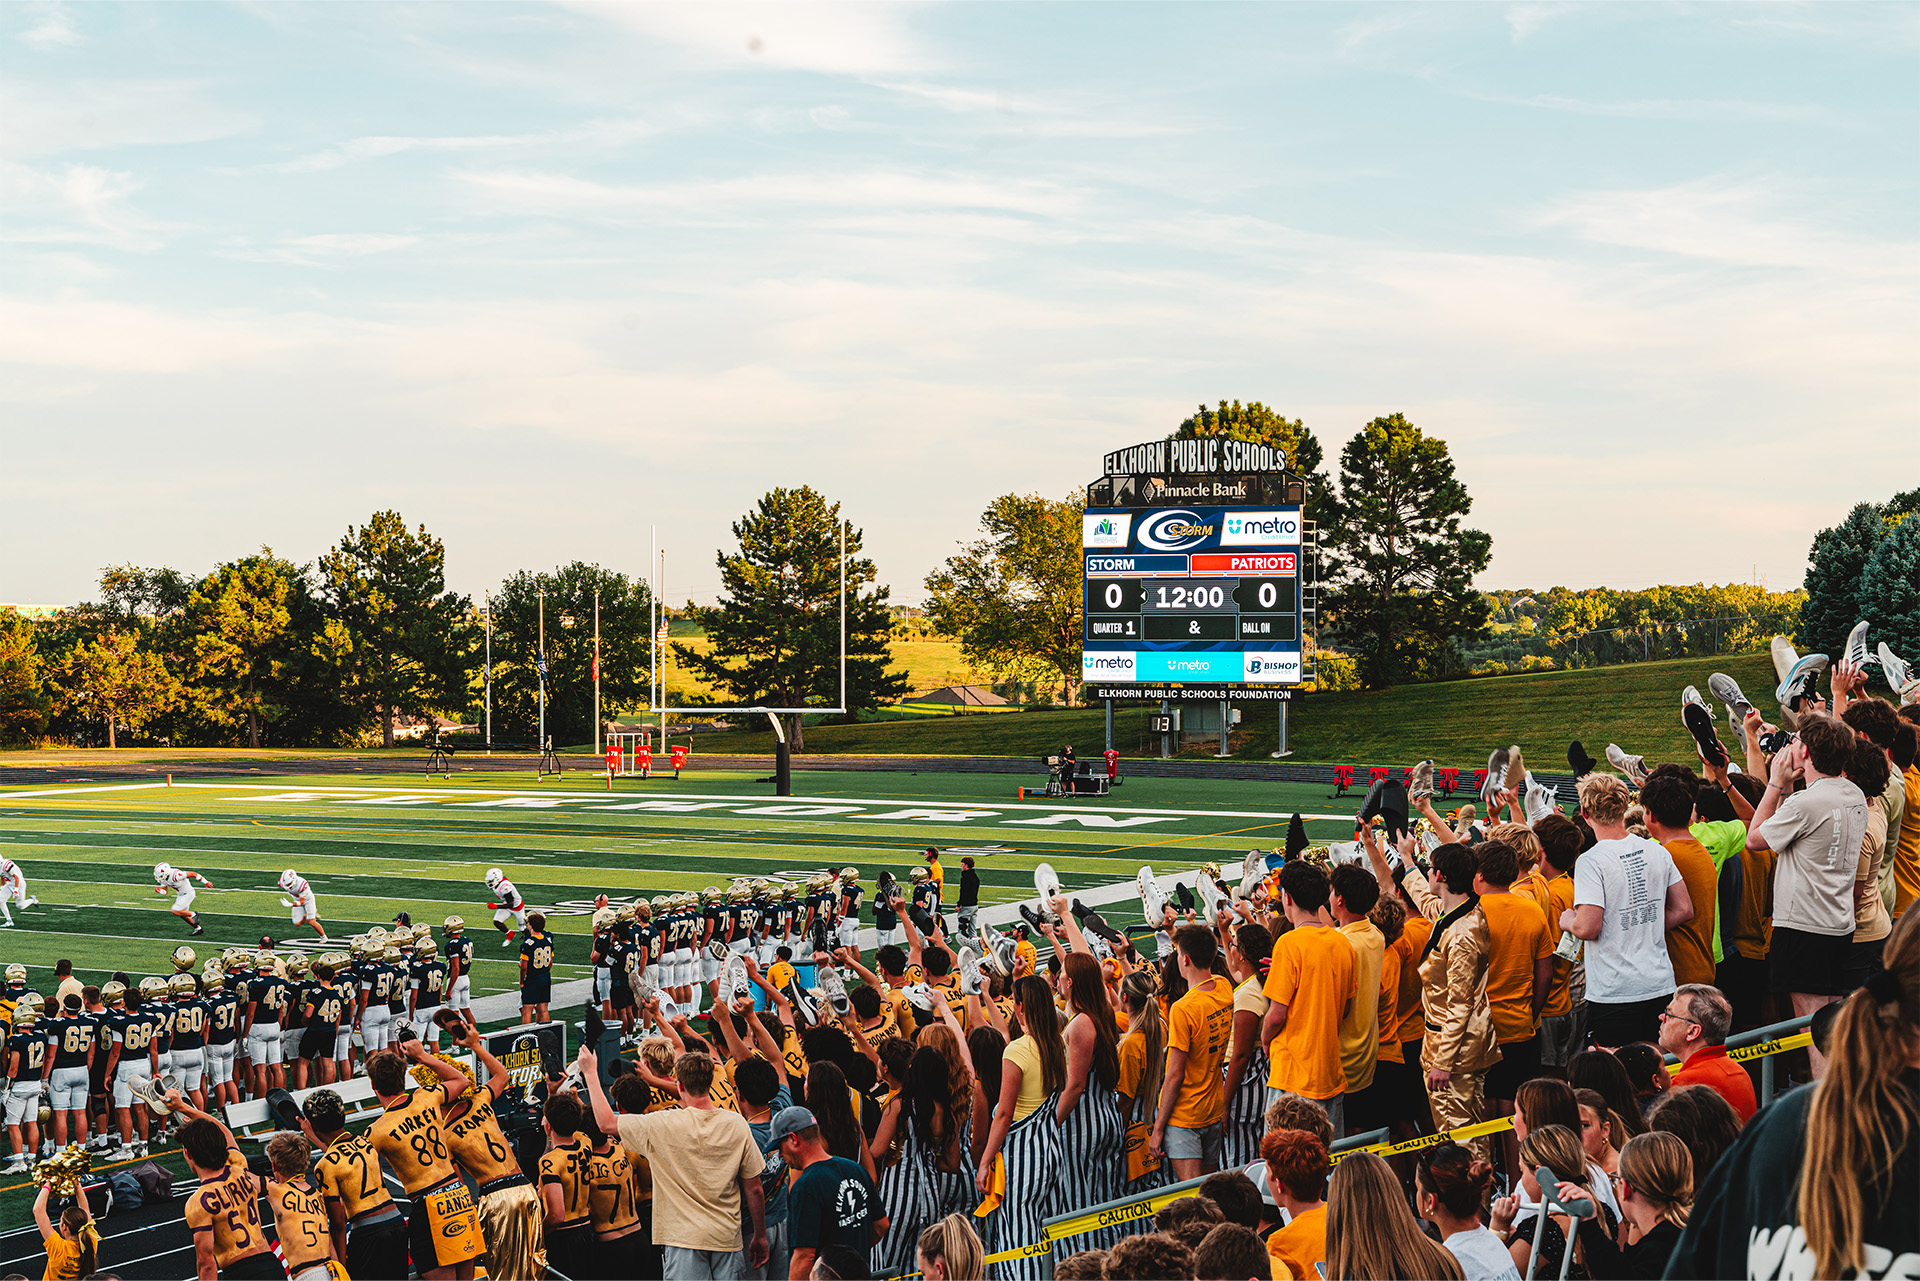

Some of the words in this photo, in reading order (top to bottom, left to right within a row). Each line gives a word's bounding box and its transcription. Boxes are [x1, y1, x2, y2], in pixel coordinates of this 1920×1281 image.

[1105, 441, 1165, 475] ELKHORN
[1170, 439, 1218, 473] PUBLIC
[1223, 440, 1286, 471] SCHOOLS
[1156, 483, 1210, 497] Pinnacle
[1212, 481, 1246, 497] Bank
[1170, 525, 1214, 537] STORM
[1245, 517, 1296, 534] metro
[1089, 558, 1135, 571] STORM
[1231, 557, 1294, 570] PATRIOTS
[1105, 583, 1123, 609] 0
[1156, 586, 1224, 608] 12:00
[1258, 582, 1277, 608] 0
[1093, 622, 1123, 634] QUARTER
[1125, 621, 1136, 635] 1
[1188, 620, 1201, 635] &
[1242, 622, 1259, 634] BALL
[1260, 622, 1271, 634] ON
[1096, 656, 1134, 669] metro
[1178, 660, 1210, 670] metro
[1264, 662, 1298, 670] BISHOP
[1098, 689, 1142, 698] ELKHORN
[1144, 690, 1178, 699] PUBLIC
[1181, 690, 1227, 699] SCHOOLS
[1229, 690, 1292, 700] FOUNDATION
[1156, 718, 1170, 732] 13
[1826, 808, 1842, 870] HOURS
[679, 919, 696, 940] 73
[533, 946, 552, 969] 88
[427, 969, 443, 993] 16
[263, 984, 285, 1010] 43
[176, 1007, 202, 1033] 60
[215, 1001, 237, 1030] 37
[318, 998, 342, 1023] 48
[64, 1026, 94, 1053] 65
[126, 1022, 152, 1050] 68
[28, 1041, 45, 1070] 12
[1729, 1040, 1783, 1061] AUTION
[389, 1106, 437, 1142] TURKEY
[452, 1102, 494, 1139] ROACH
[410, 1124, 448, 1167] 88
[484, 1132, 506, 1163] 6
[597, 1176, 634, 1225] 71
[227, 1196, 259, 1250] 54
[1098, 1200, 1153, 1227] CAUTION
[1022, 1240, 1051, 1257] CAU
